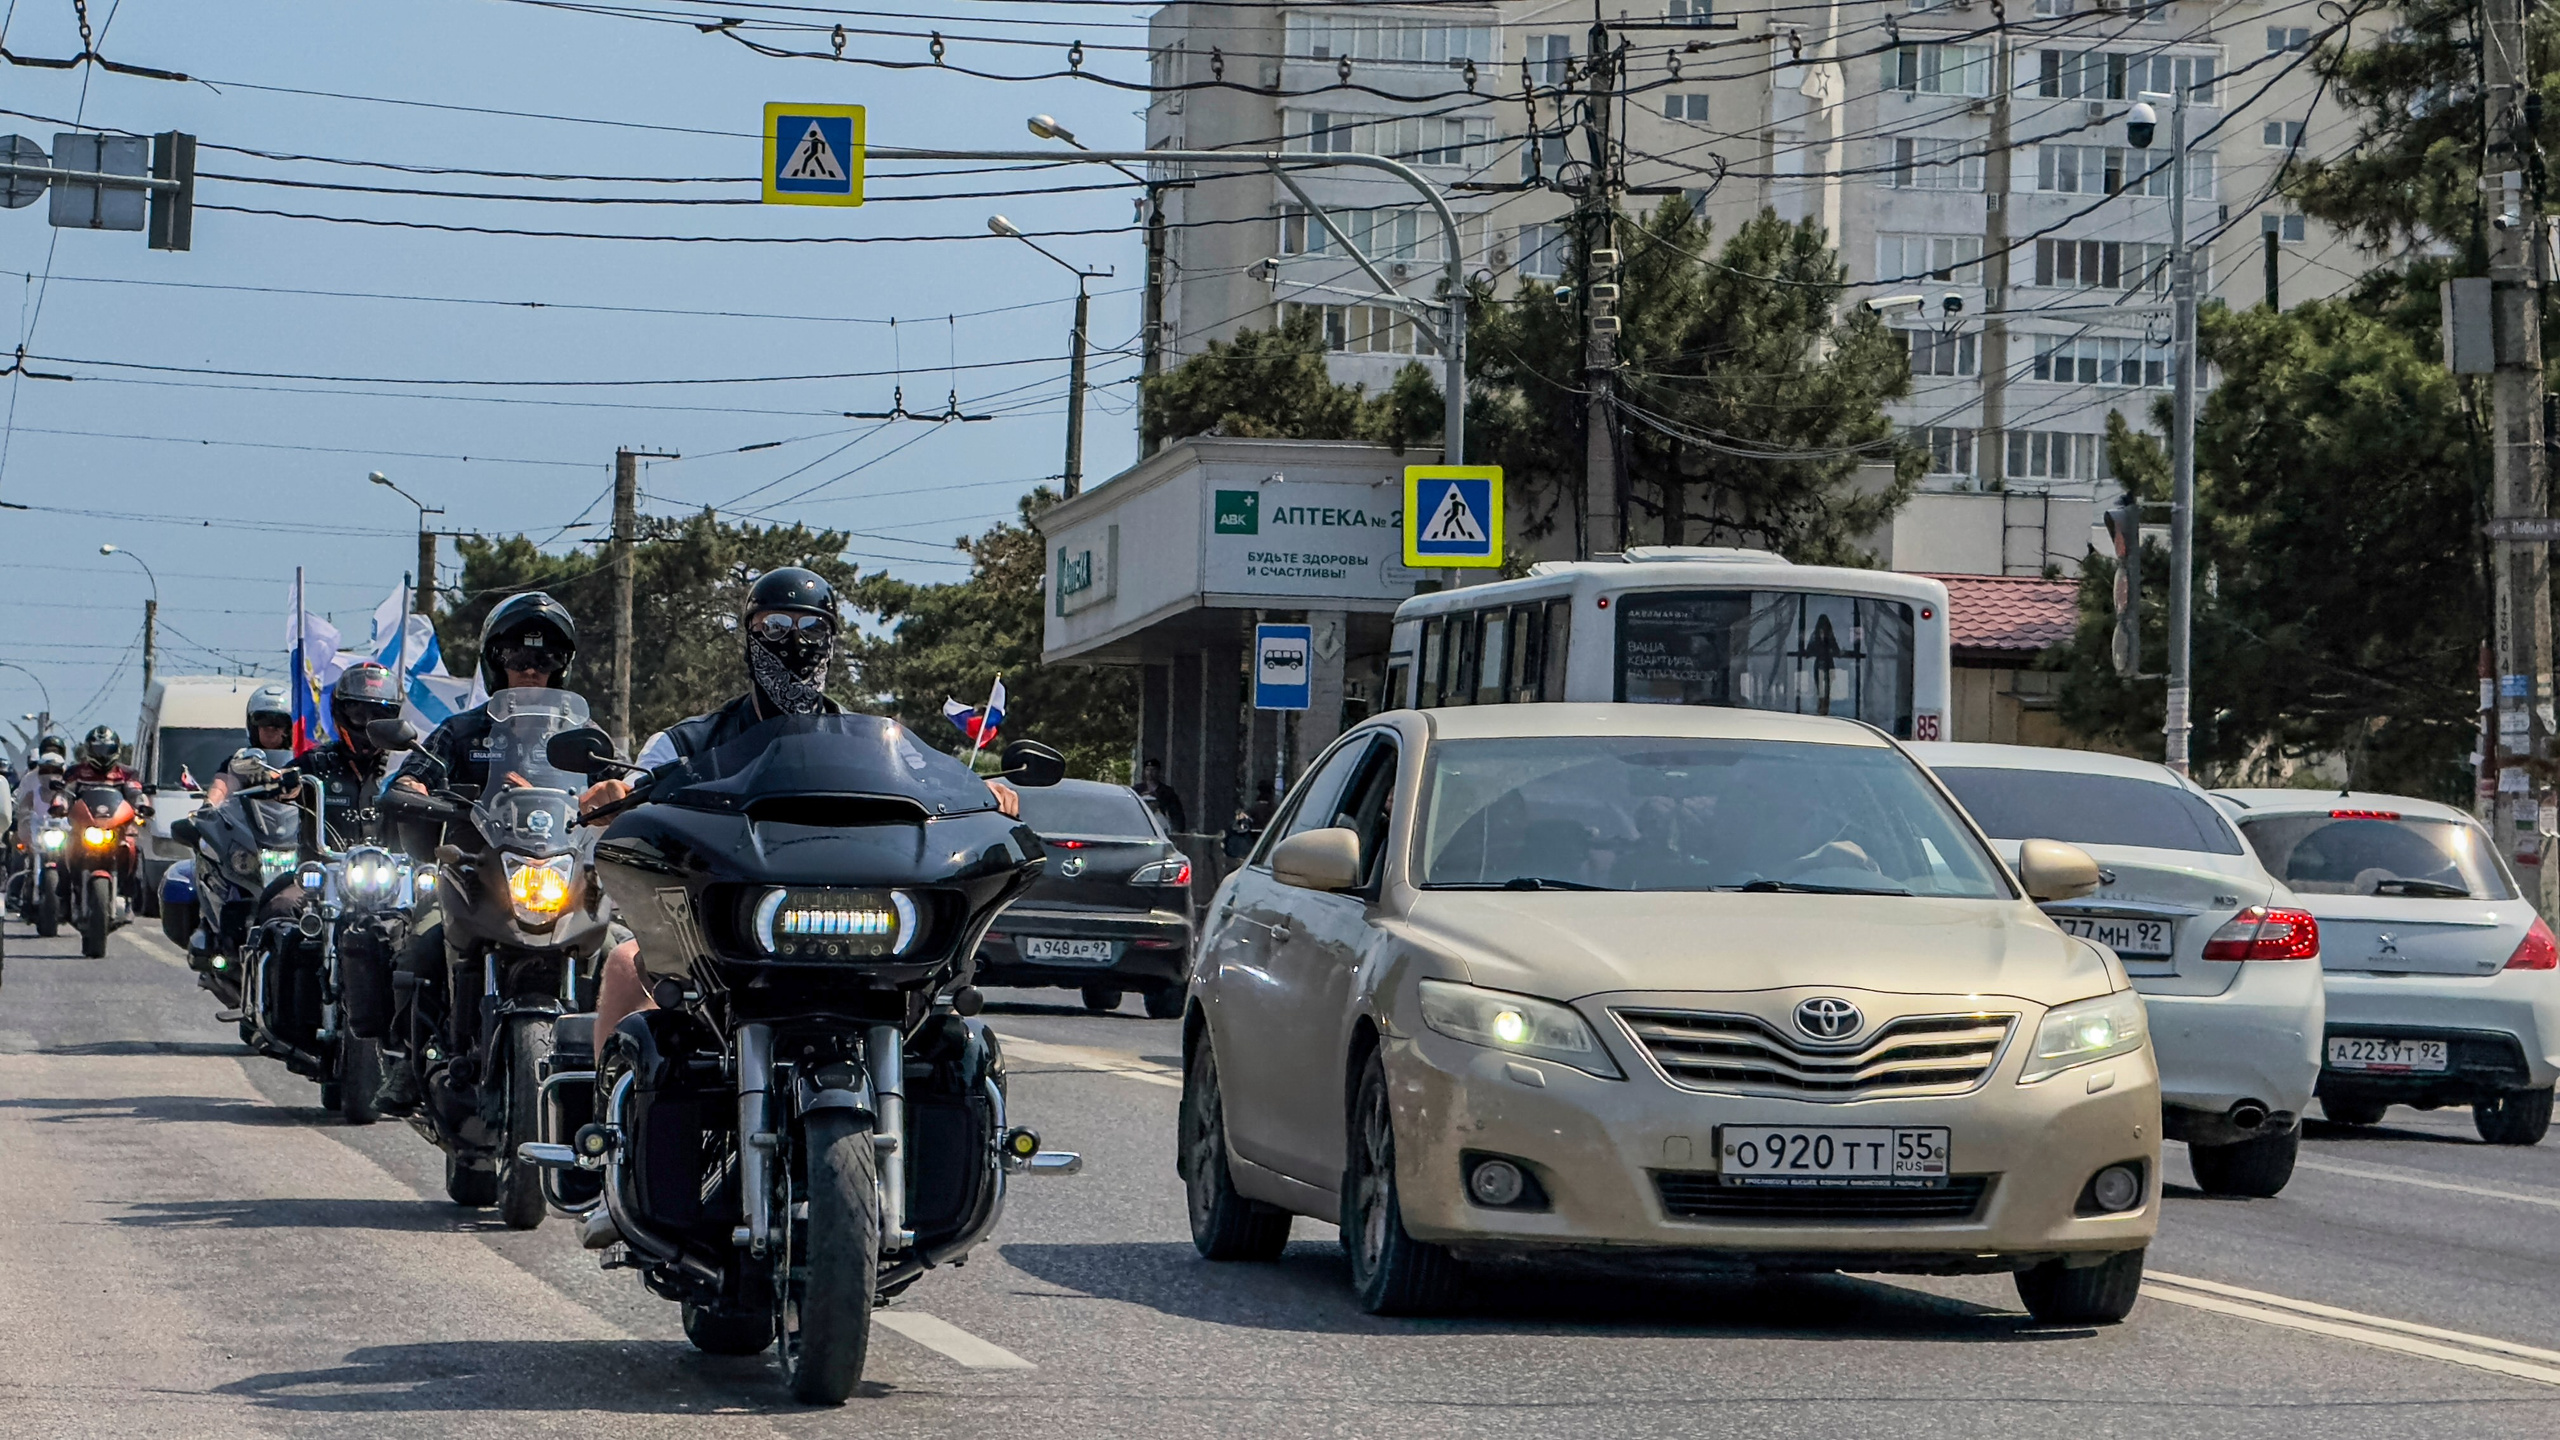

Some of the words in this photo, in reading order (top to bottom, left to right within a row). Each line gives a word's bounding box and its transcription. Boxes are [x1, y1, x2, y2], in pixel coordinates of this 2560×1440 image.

[1219, 513, 1247, 526] АВК
[1272, 506, 1367, 527] АПТЕКА
[1248, 552, 1298, 565] БУДЬТЕ
[1302, 553, 1369, 566] ЗДОРОВЫ
[1248, 567, 1256, 576] И
[1260, 566, 1346, 579] СЧАСТЛИВЫ!
[1917, 714, 1938, 741] 85
[2053, 918, 2130, 948] 77МН
[2137, 922, 2162, 942] 92
[1093, 942, 1107, 953] 92
[2421, 1042, 2441, 1058] 92
[1896, 1133, 1933, 1160] 55
[1895, 1161, 1923, 1172] RUS
